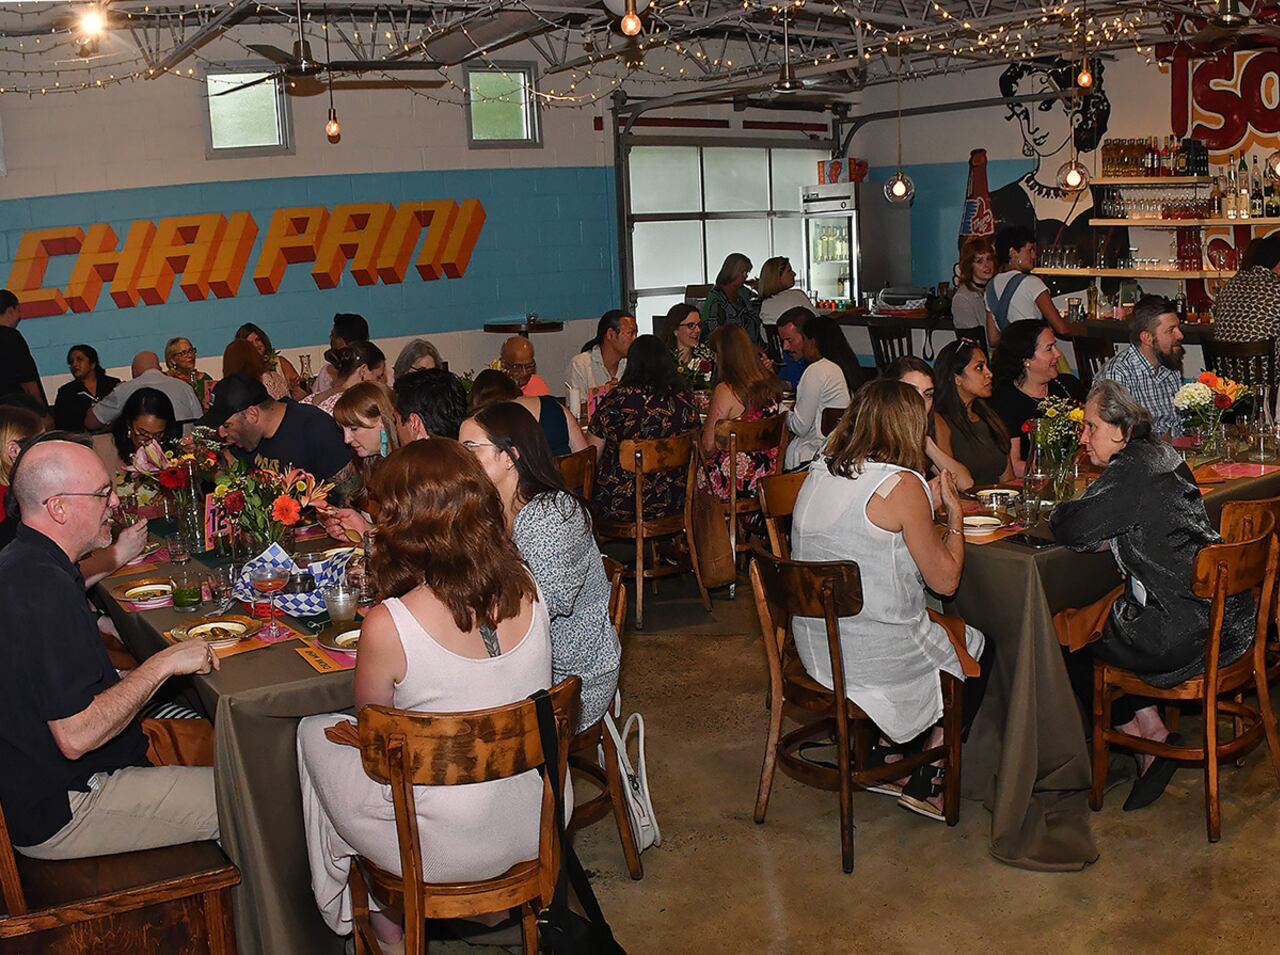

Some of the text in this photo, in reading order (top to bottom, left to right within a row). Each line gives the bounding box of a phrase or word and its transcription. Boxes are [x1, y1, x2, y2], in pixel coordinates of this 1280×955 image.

[5, 198, 487, 320] CHAI PANI
[209, 508, 228, 532] 12
